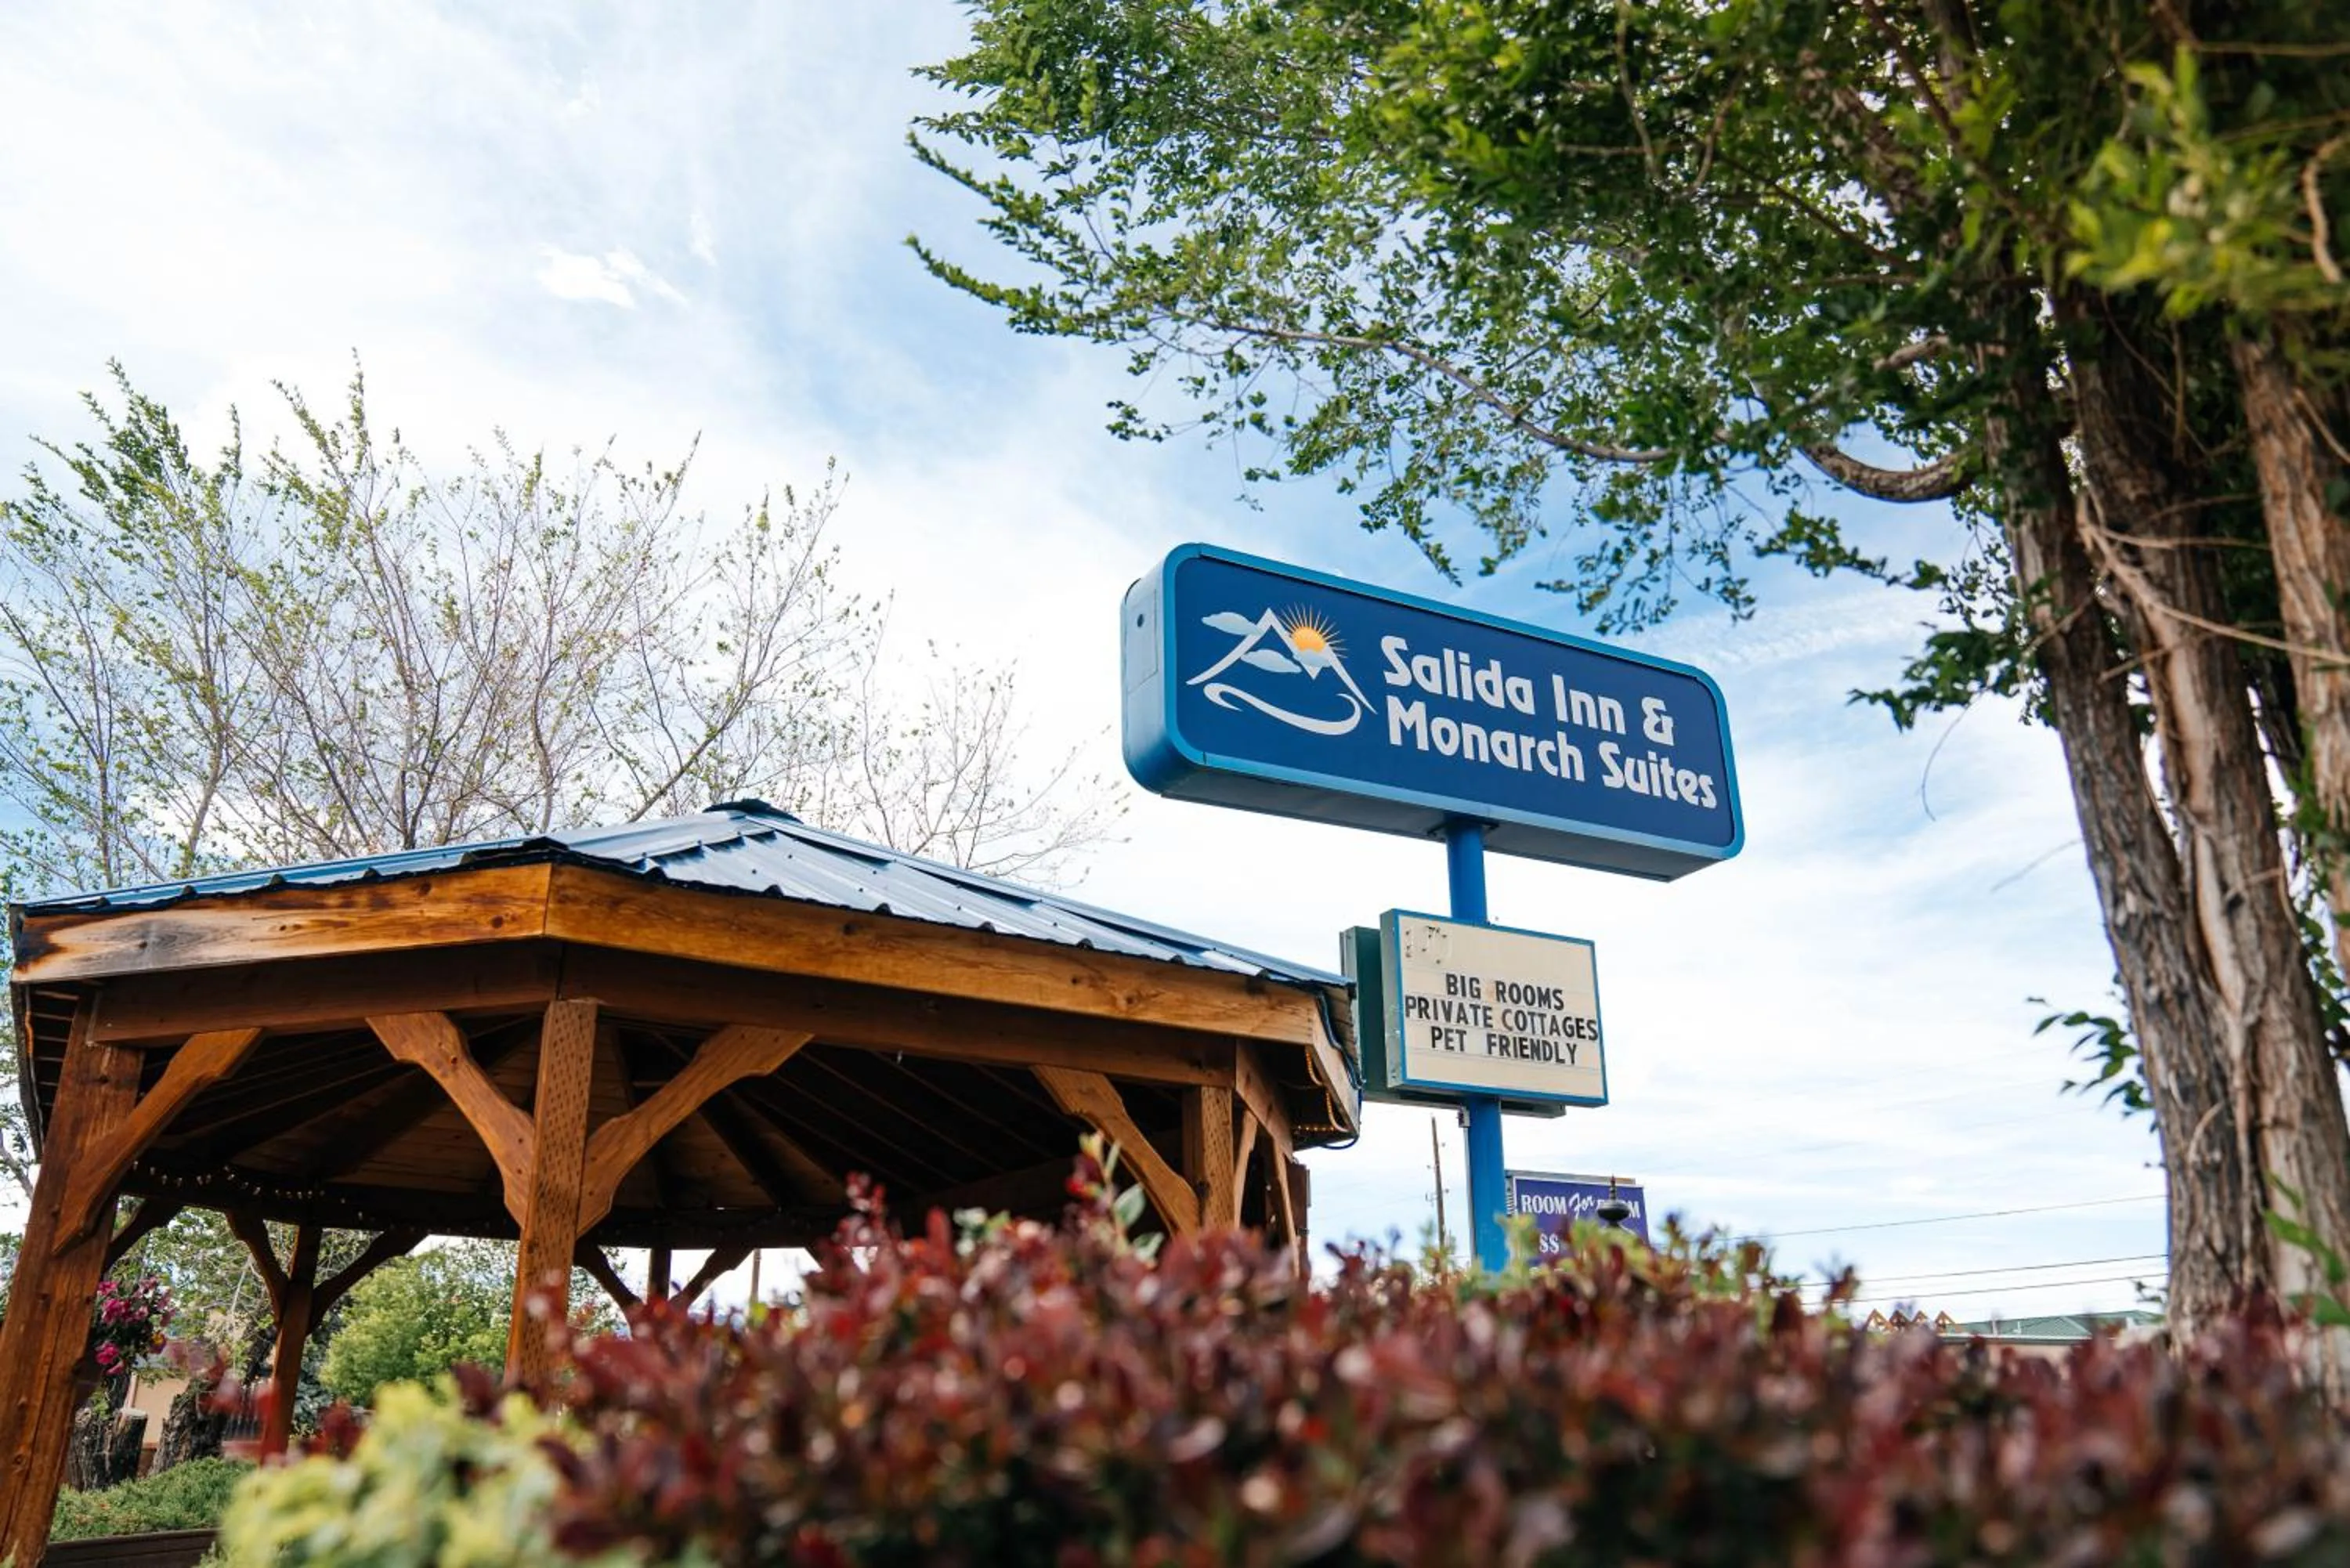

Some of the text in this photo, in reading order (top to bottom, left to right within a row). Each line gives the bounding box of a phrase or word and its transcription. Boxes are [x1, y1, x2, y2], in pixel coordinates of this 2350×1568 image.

[1381, 635, 1674, 746] Salida Inn &
[1386, 695, 1717, 809] Monarch Suites
[1445, 974, 1564, 1011] BIG ROOMS
[1405, 995, 1599, 1041] PRIVATE COTTAGES
[1431, 1027, 1578, 1064] PET FRIENDLY
[1520, 1194, 1567, 1215] ROOM
